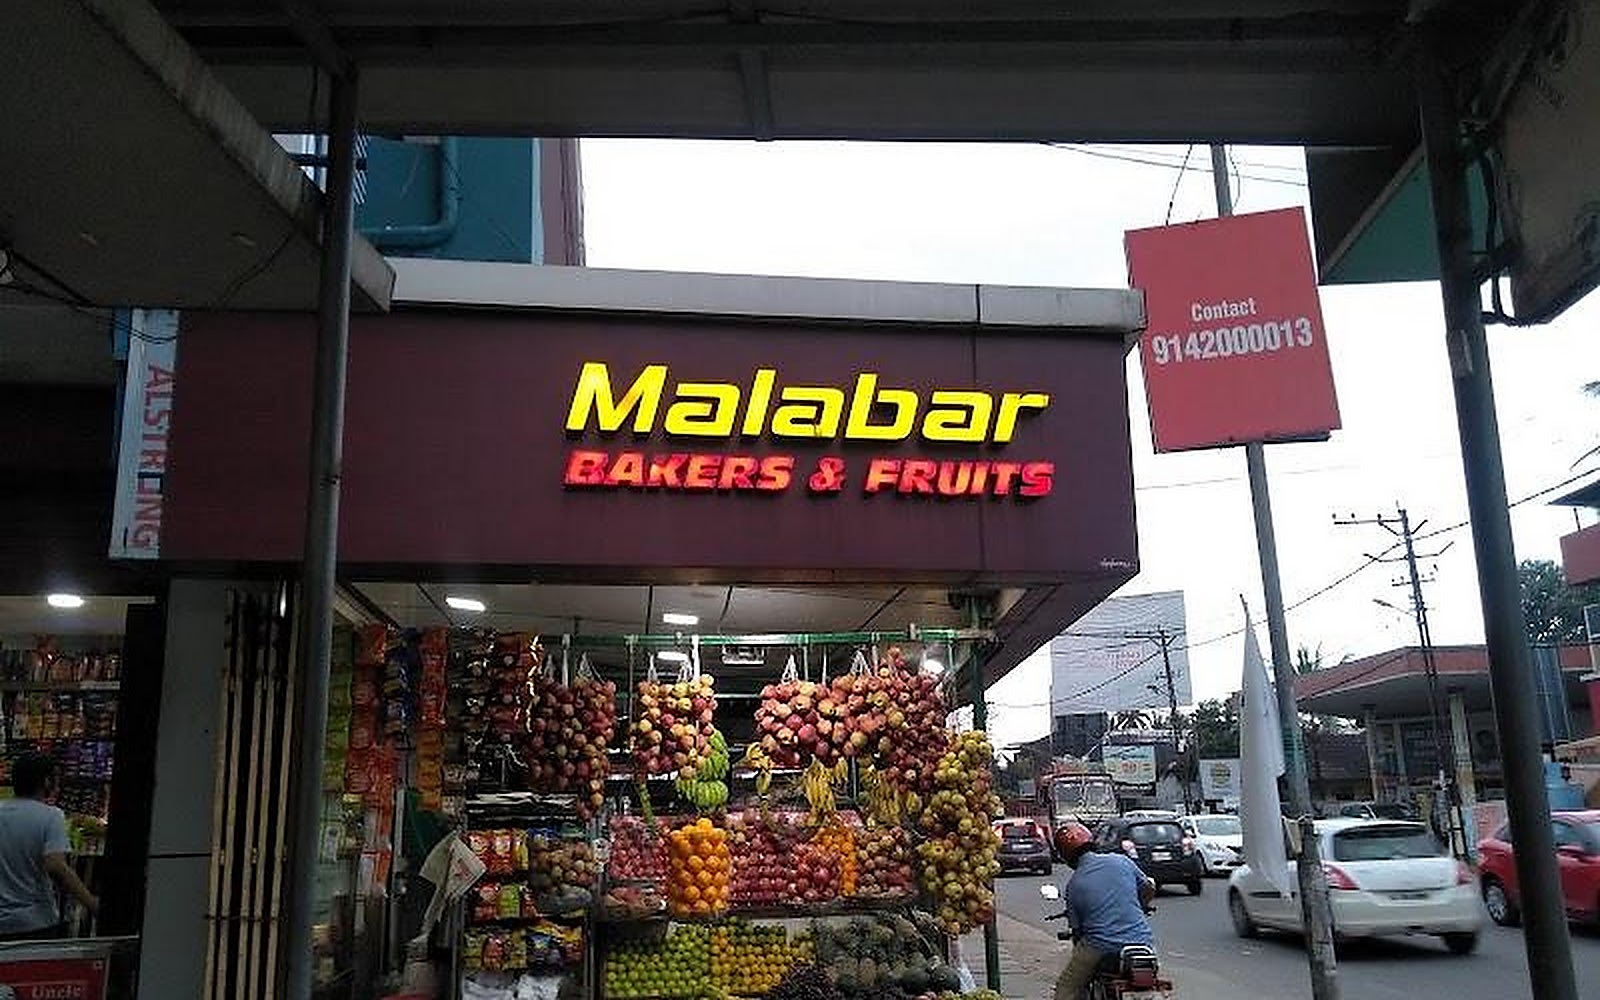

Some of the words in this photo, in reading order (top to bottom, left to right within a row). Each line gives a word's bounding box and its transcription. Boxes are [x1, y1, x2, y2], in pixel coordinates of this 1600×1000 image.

[1191, 297, 1256, 321] Contact
[1152, 317, 1313, 365] 9142000013
[565, 362, 1049, 443] Malabar
[564, 450, 794, 492] BAKERS
[808, 456, 847, 493] &
[865, 457, 1055, 498] FRUITS
